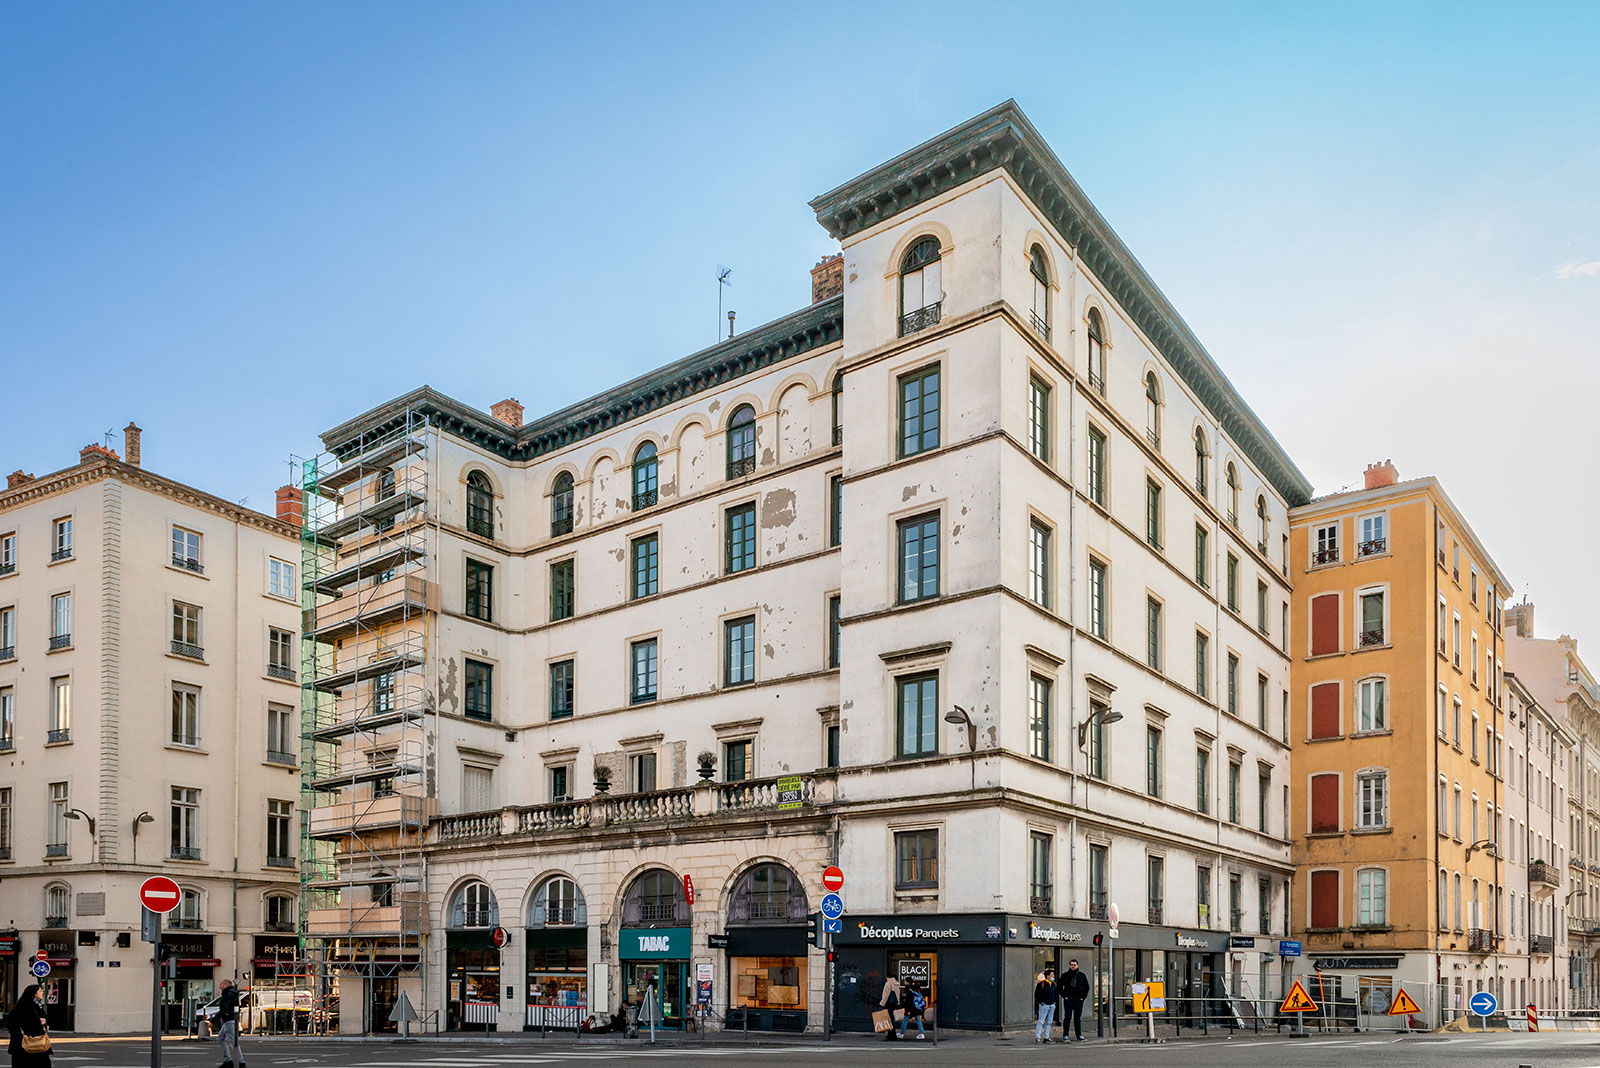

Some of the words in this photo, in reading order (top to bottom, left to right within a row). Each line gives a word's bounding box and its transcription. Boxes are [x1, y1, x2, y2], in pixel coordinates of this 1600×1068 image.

[861, 926, 913, 941] Décoplus
[915, 928, 959, 940] Parquets
[1031, 926, 1060, 942] Décoplus
[1061, 931, 1082, 942] Parquets
[638, 936, 670, 952] TABAC
[901, 965, 927, 975] BLACK
